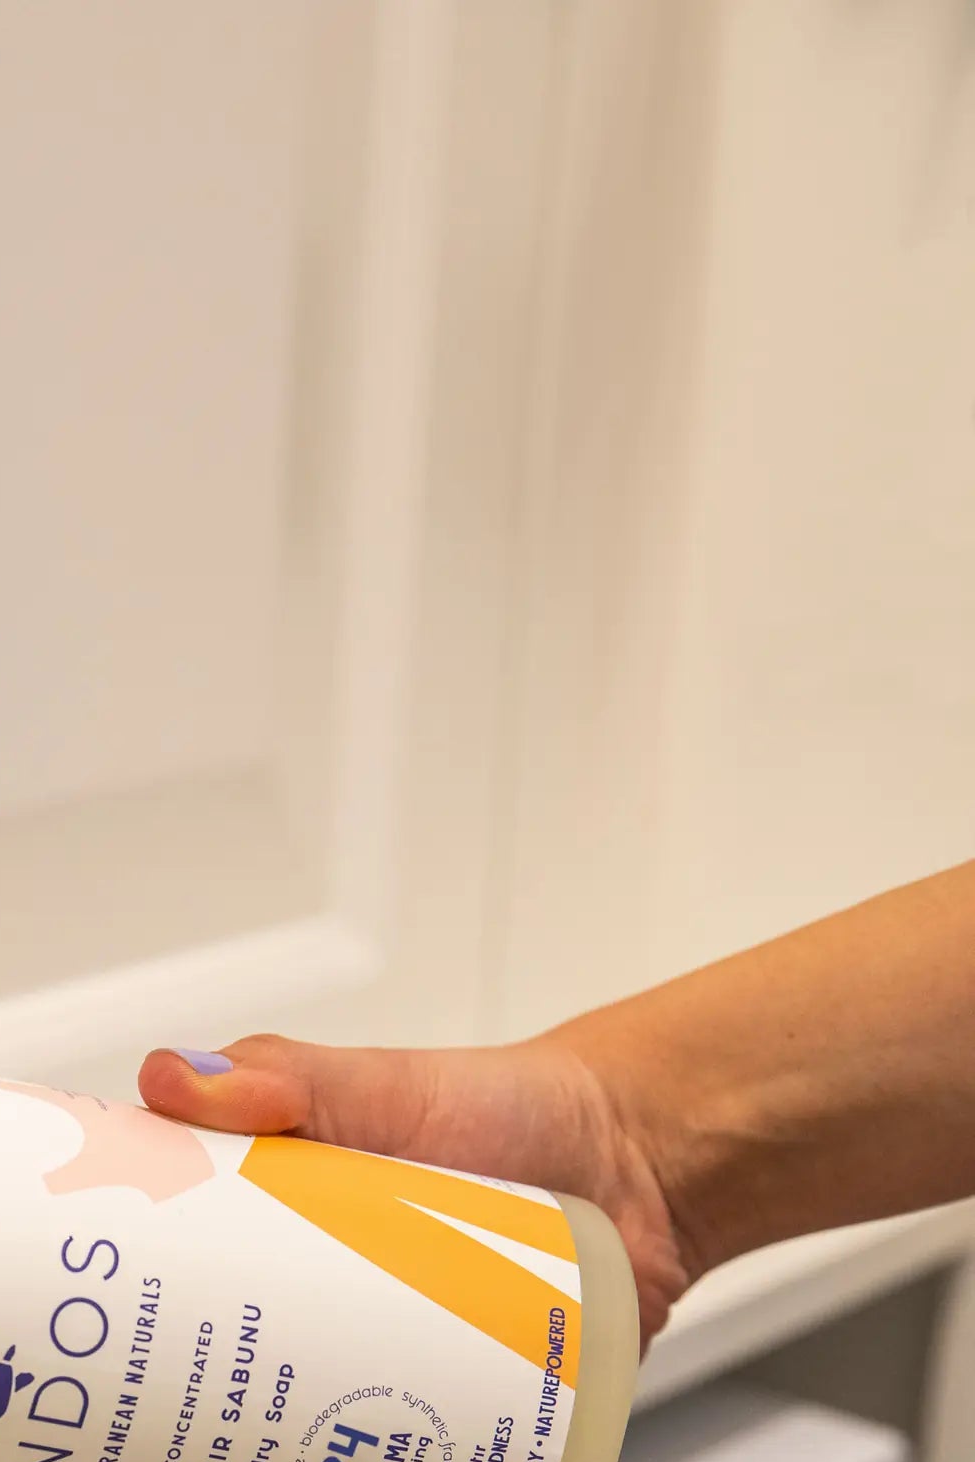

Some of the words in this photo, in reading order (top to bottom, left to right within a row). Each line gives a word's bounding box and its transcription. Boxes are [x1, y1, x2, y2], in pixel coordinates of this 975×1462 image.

[124, 1277, 161, 1384] NATURALS
[222, 1304, 261, 1423] SABUNU
[534, 1307, 565, 1436] NATUREPOWERED
[265, 1364, 295, 1423] Soap
[300, 1385, 393, 1447] biodegradable
[402, 1392, 449, 1440] synthetic
